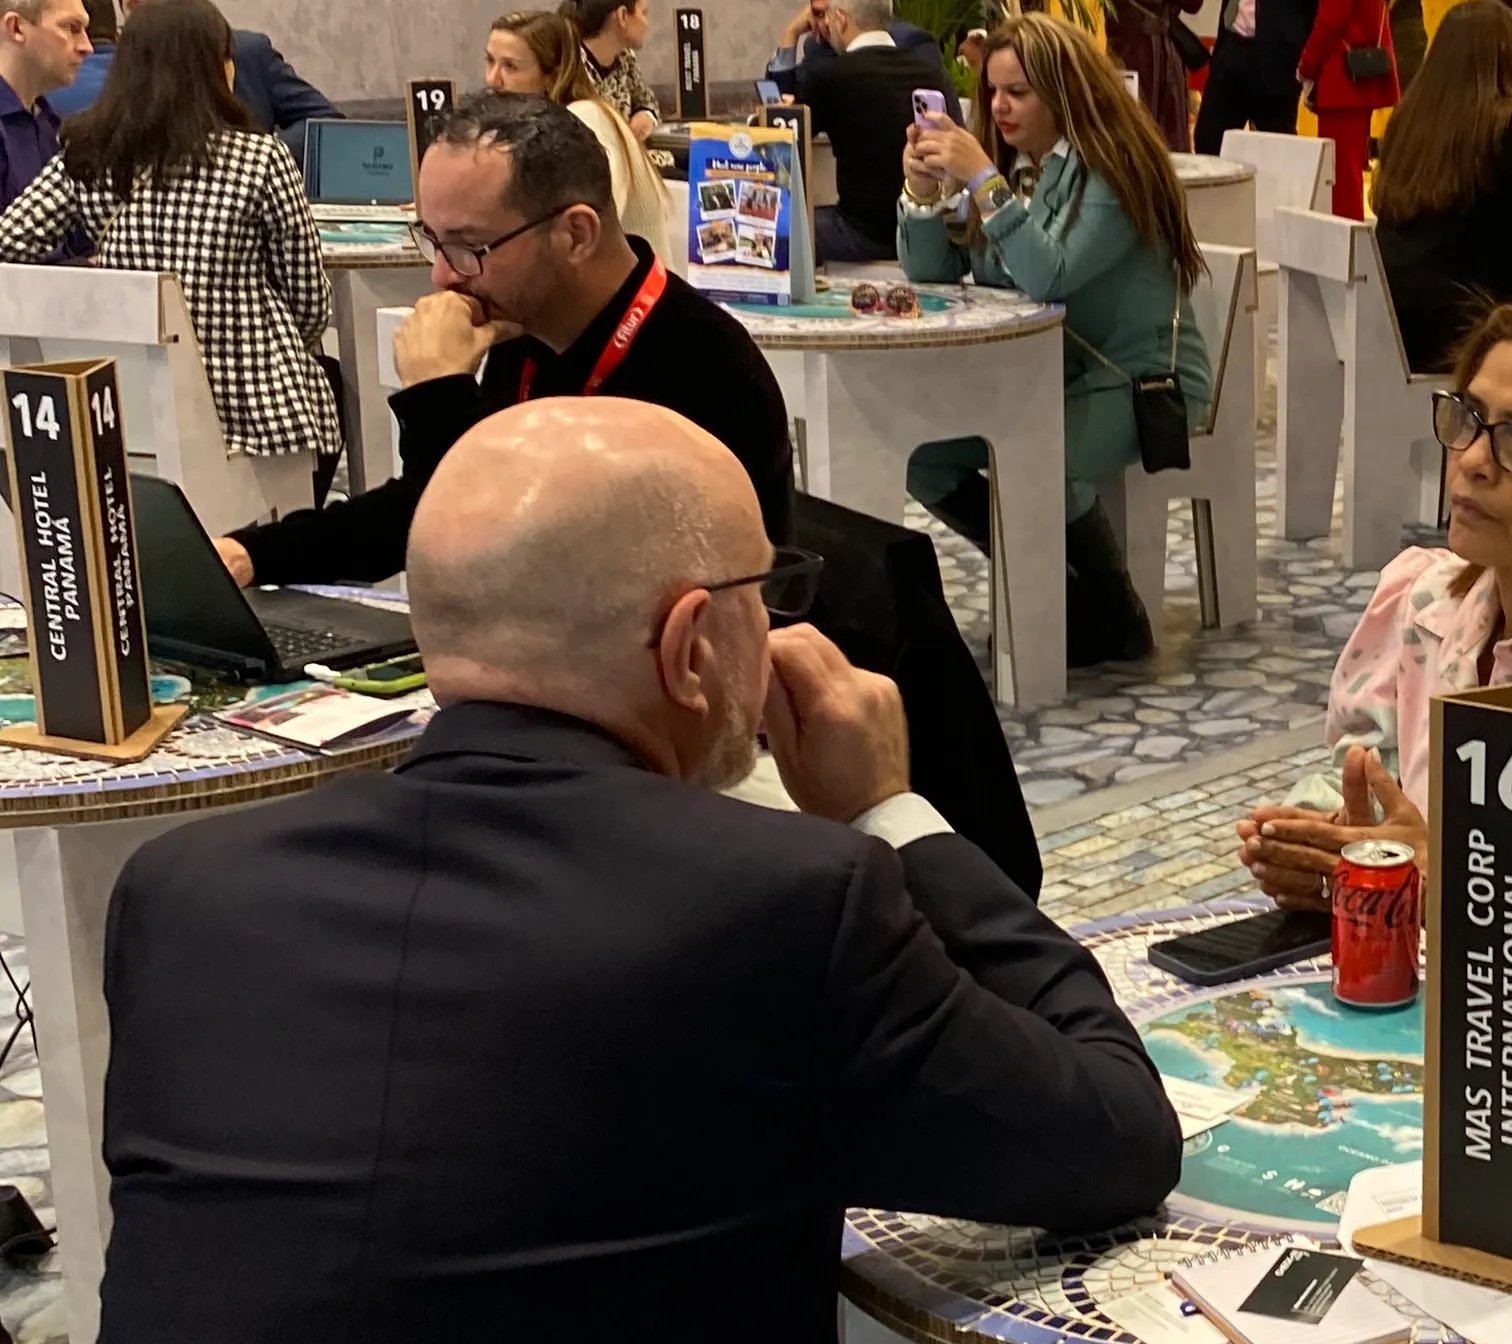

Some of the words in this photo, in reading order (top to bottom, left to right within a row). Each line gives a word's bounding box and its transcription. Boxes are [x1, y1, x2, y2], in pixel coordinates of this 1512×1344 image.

[416, 88, 446, 112] 19
[12, 392, 61, 441] 14
[91, 385, 116, 436] 14
[31, 470, 55, 547] HOTEL
[104, 464, 119, 544] HOTEL
[49, 516, 81, 621] PANAMÁ
[113, 553, 131, 657] CENTRAL
[41, 558, 68, 662] CENTRAL
[1467, 827, 1497, 928] CORP
[1465, 944, 1495, 1070] TRAVEL
[1465, 1084, 1493, 1162] MAS
